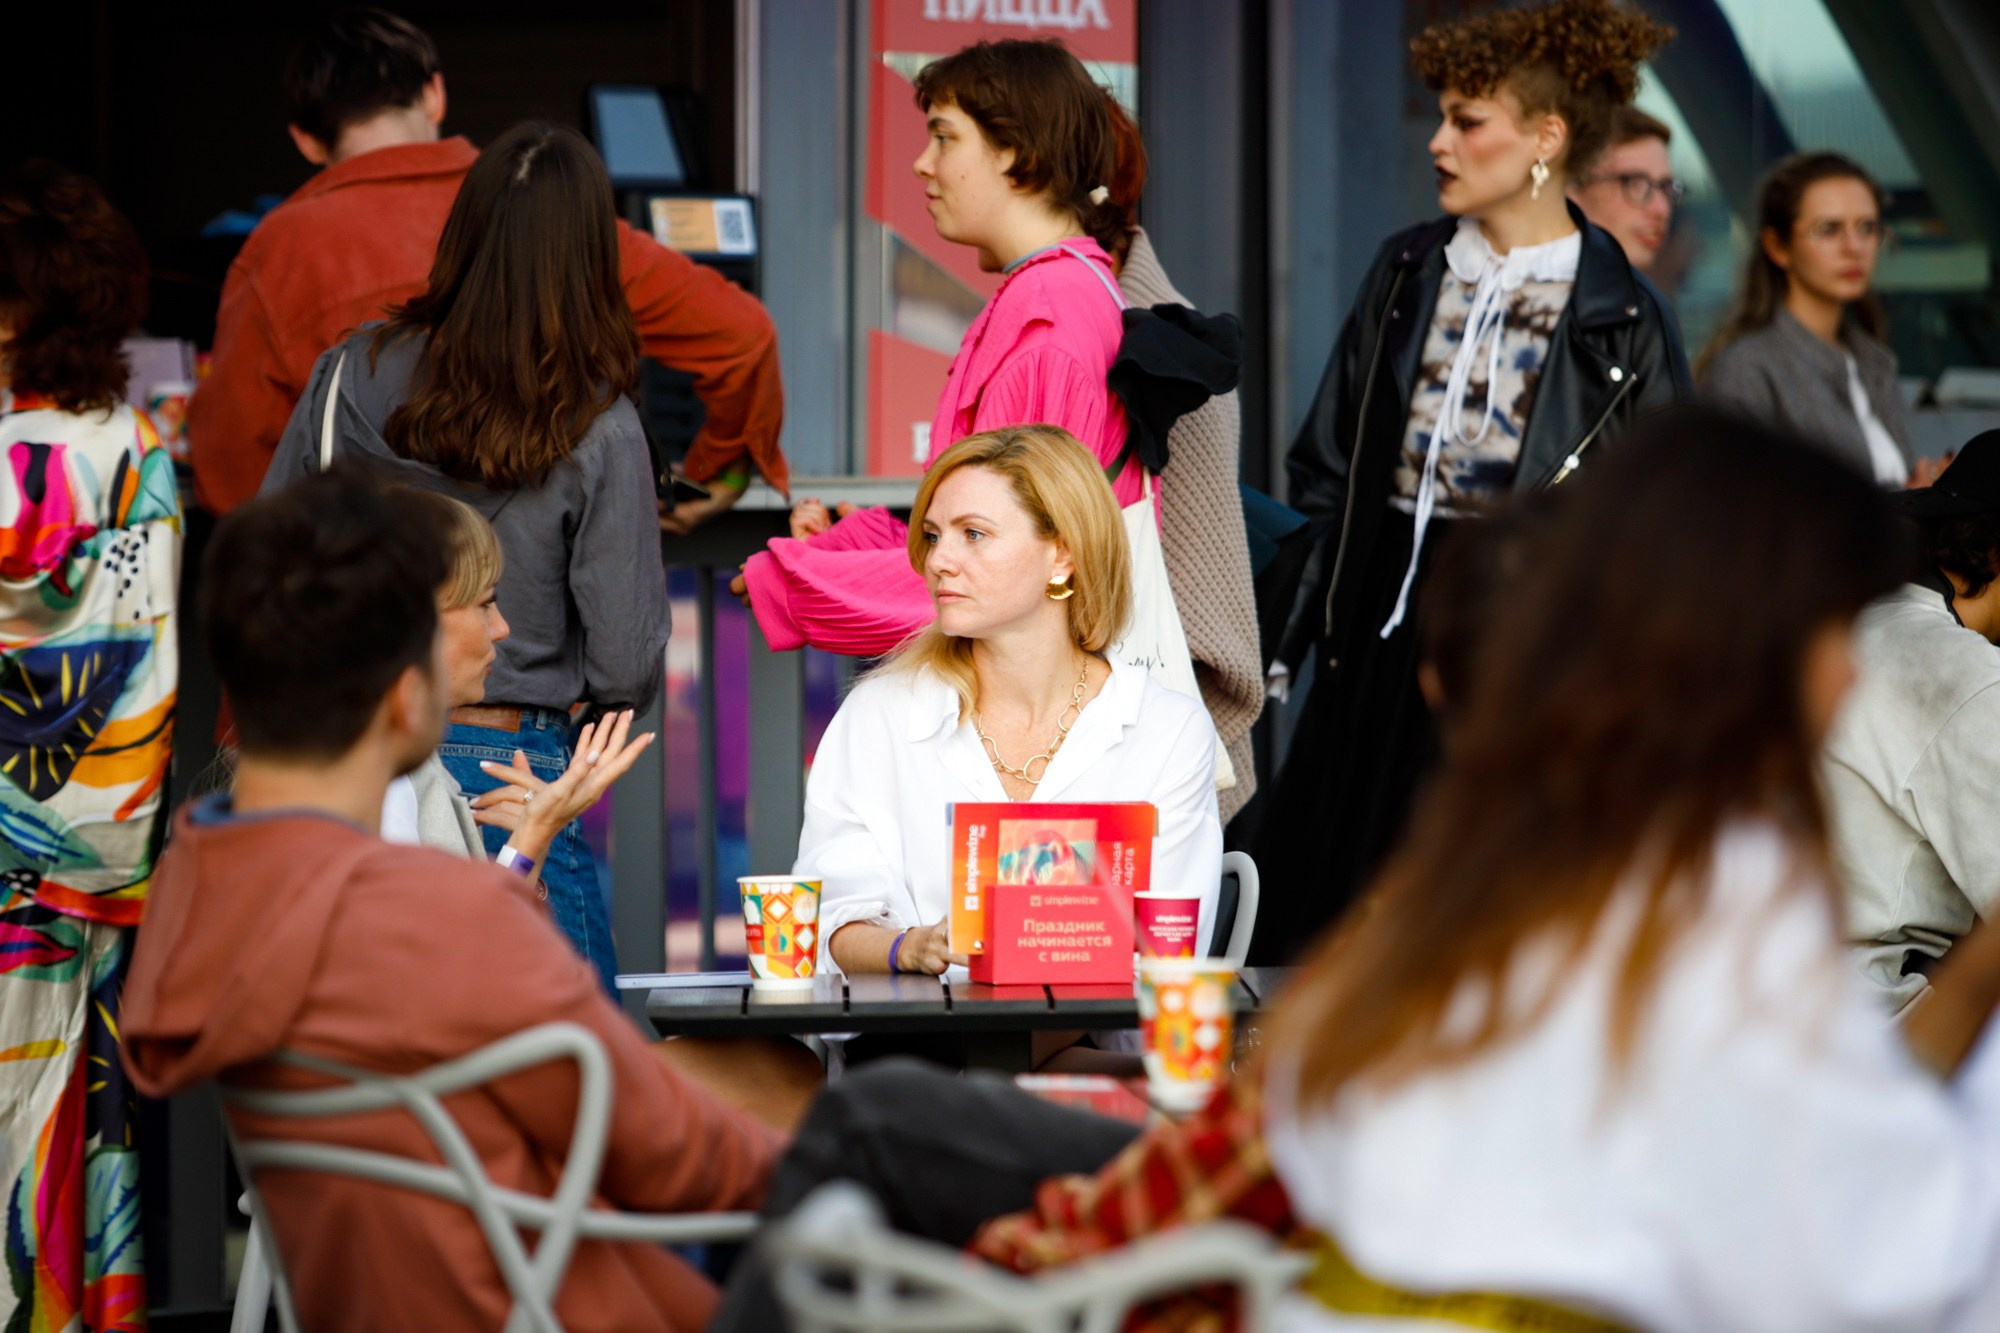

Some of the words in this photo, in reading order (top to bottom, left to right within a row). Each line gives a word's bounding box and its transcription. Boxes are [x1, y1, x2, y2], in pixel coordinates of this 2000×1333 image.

[1043, 895, 1099, 907] simplewine
[1023, 918, 1105, 935] Праздник
[1017, 935, 1112, 948] начинается
[1038, 951, 1048, 962] с
[1050, 951, 1091, 962] вина
